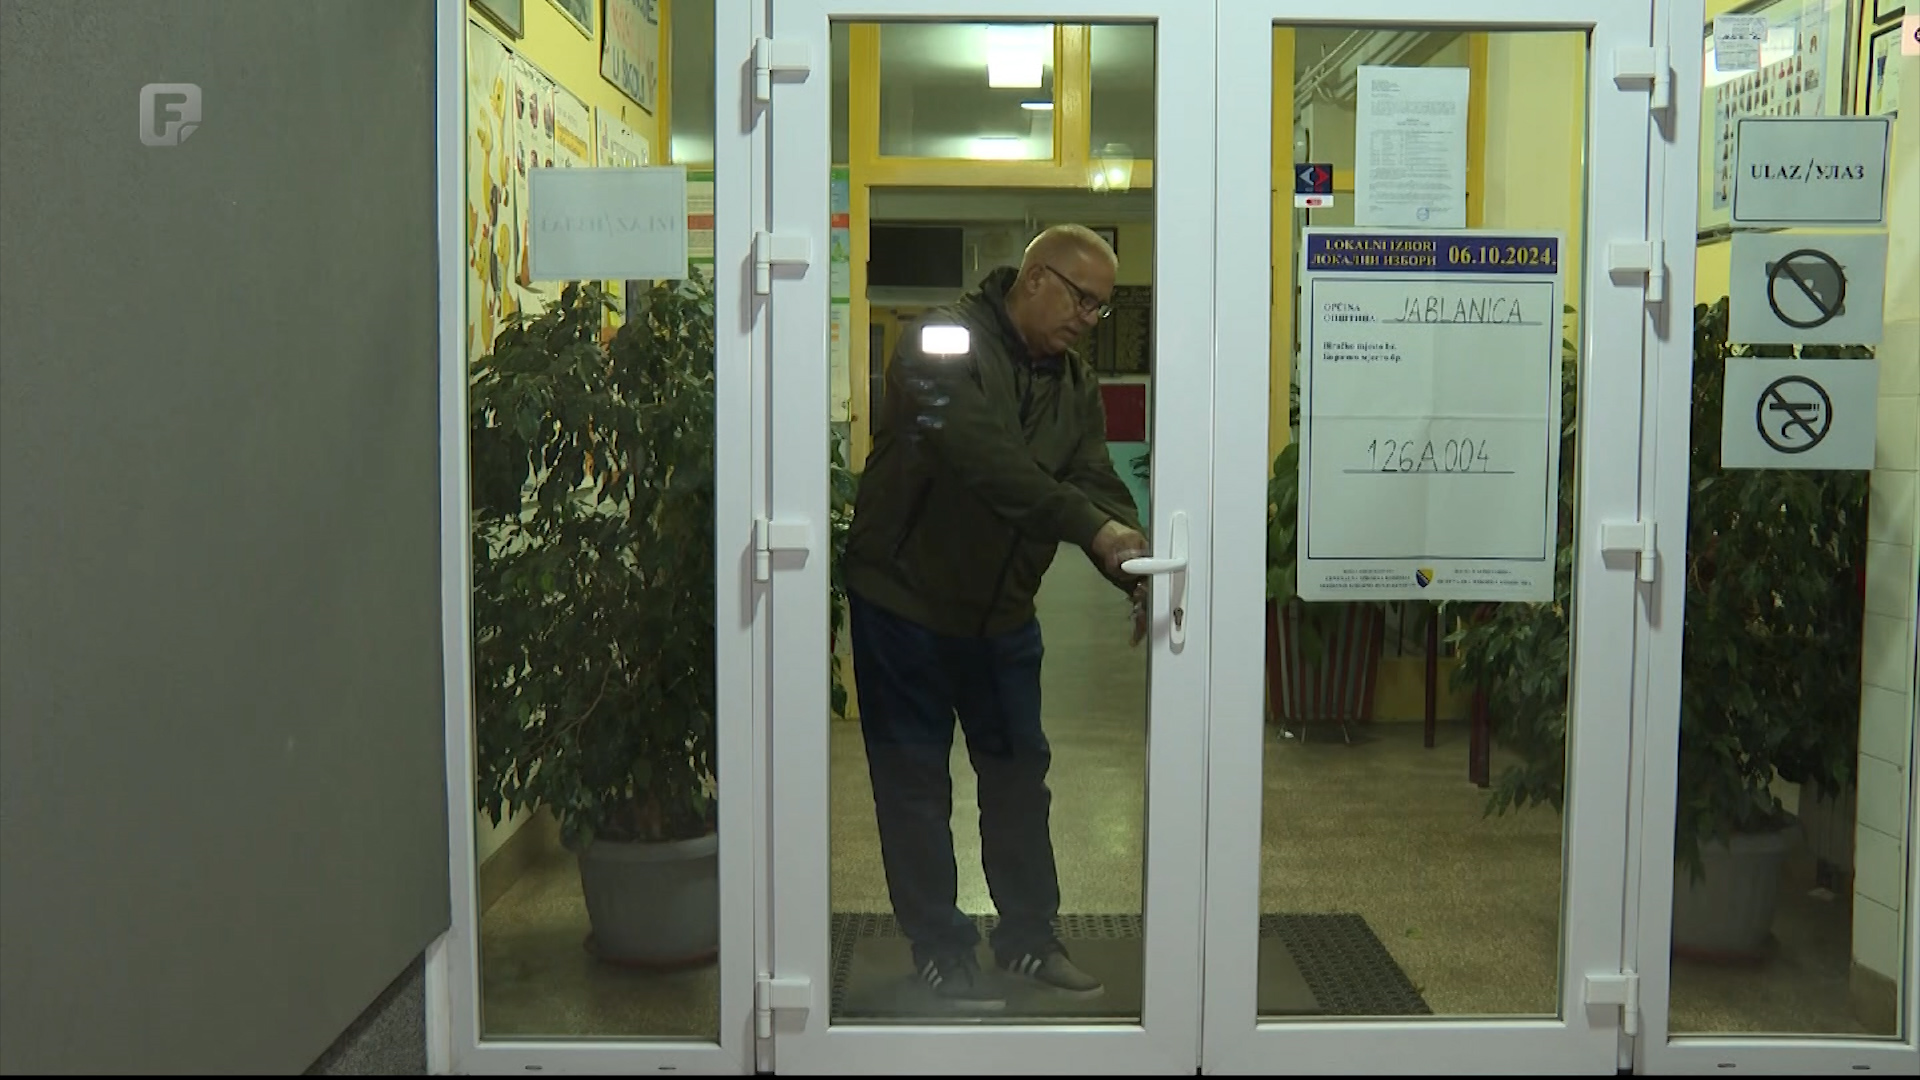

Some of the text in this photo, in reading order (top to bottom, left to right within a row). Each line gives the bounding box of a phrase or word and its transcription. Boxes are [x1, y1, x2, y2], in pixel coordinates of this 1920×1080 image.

[1751, 158, 1864, 183] ULAZ/УЛАЗ
[1325, 239, 1437, 252] LOKALNI IZBORI
[1448, 245, 1557, 267] 06.10.2024.
[1311, 253, 1437, 266] ЛОКАЛНИ ИЗБОРИ
[1395, 296, 1522, 323] JABLANICA
[1367, 437, 1490, 473] 126A004
